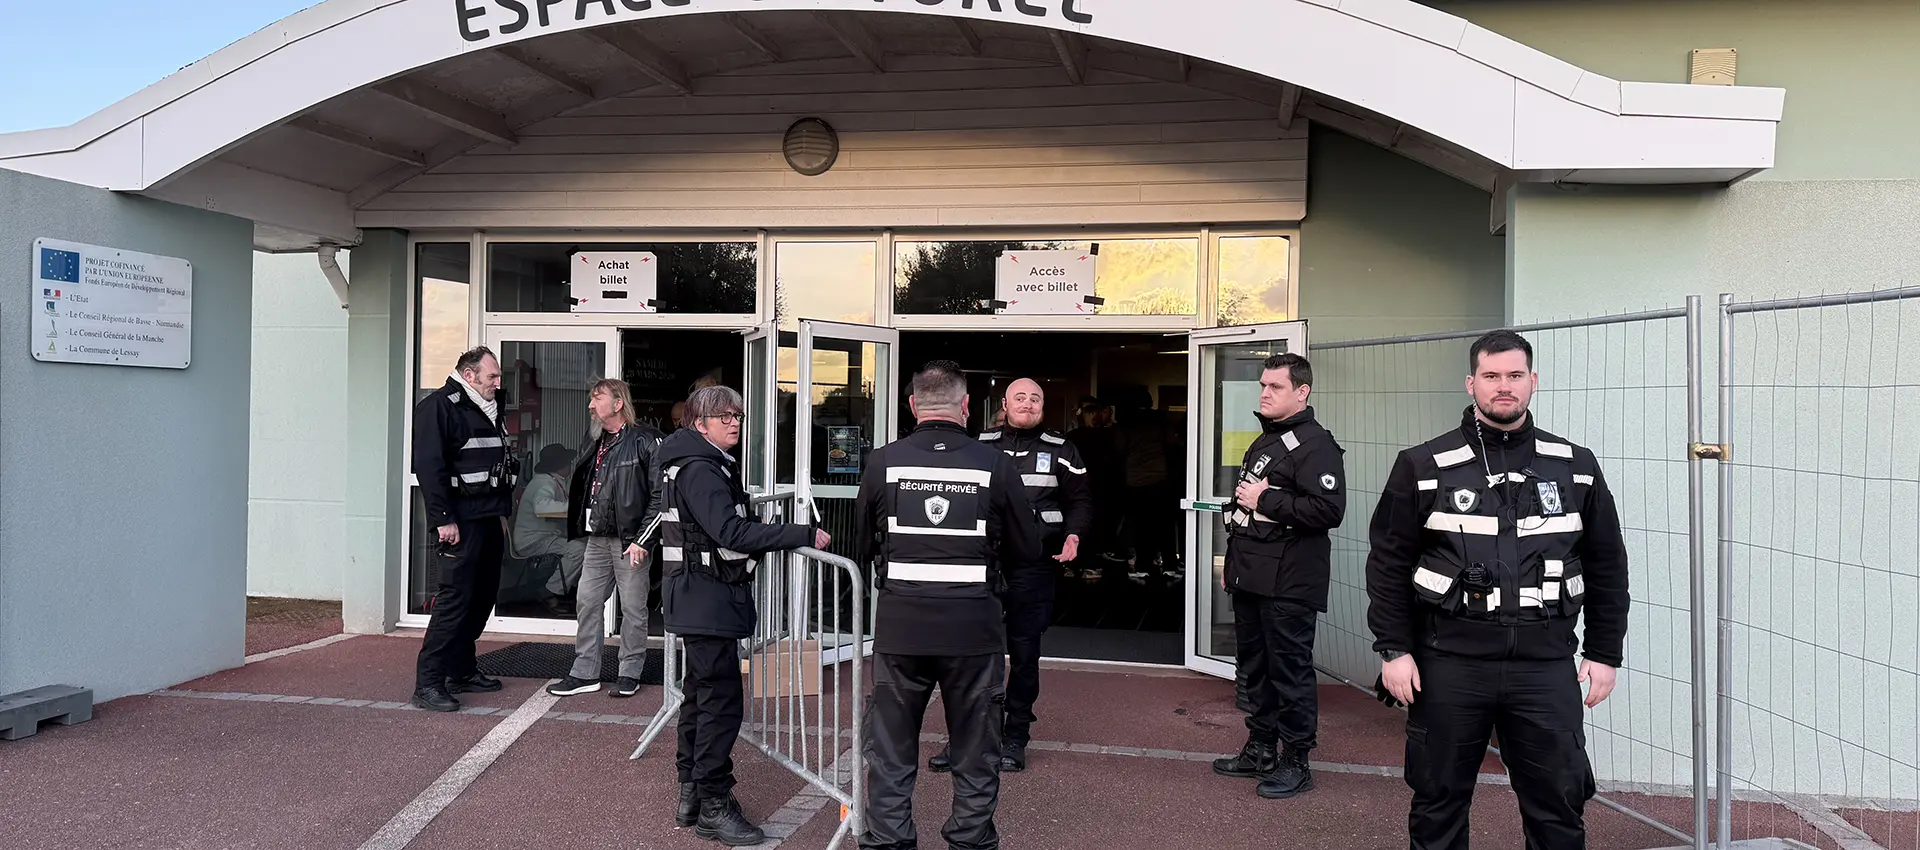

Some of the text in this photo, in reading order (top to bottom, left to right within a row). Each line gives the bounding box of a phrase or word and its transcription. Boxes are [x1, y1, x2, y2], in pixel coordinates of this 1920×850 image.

[85, 257, 109, 267] PROJET
[598, 260, 630, 270] Achat
[85, 267, 97, 276] PAR
[99, 269, 124, 279] L'UNION
[1029, 265, 1066, 276] Accès
[85, 277, 100, 286] Fonds
[600, 275, 628, 284] billet
[1016, 281, 1078, 292] avec billet
[79, 311, 101, 321] Conseil
[102, 313, 127, 323] Régional
[135, 317, 151, 326] Basse
[69, 328, 78, 336] Le
[79, 329, 102, 338] Conseil
[103, 330, 126, 340] Général
[127, 333, 135, 341] de
[136, 333, 141, 341] la
[142, 334, 164, 343] Manche
[69, 344, 78, 352] La
[79, 345, 111, 354] Commune
[120, 348, 139, 358] Lessay
[899, 481, 978, 494] SÉCURITÉ PRIVÉE
